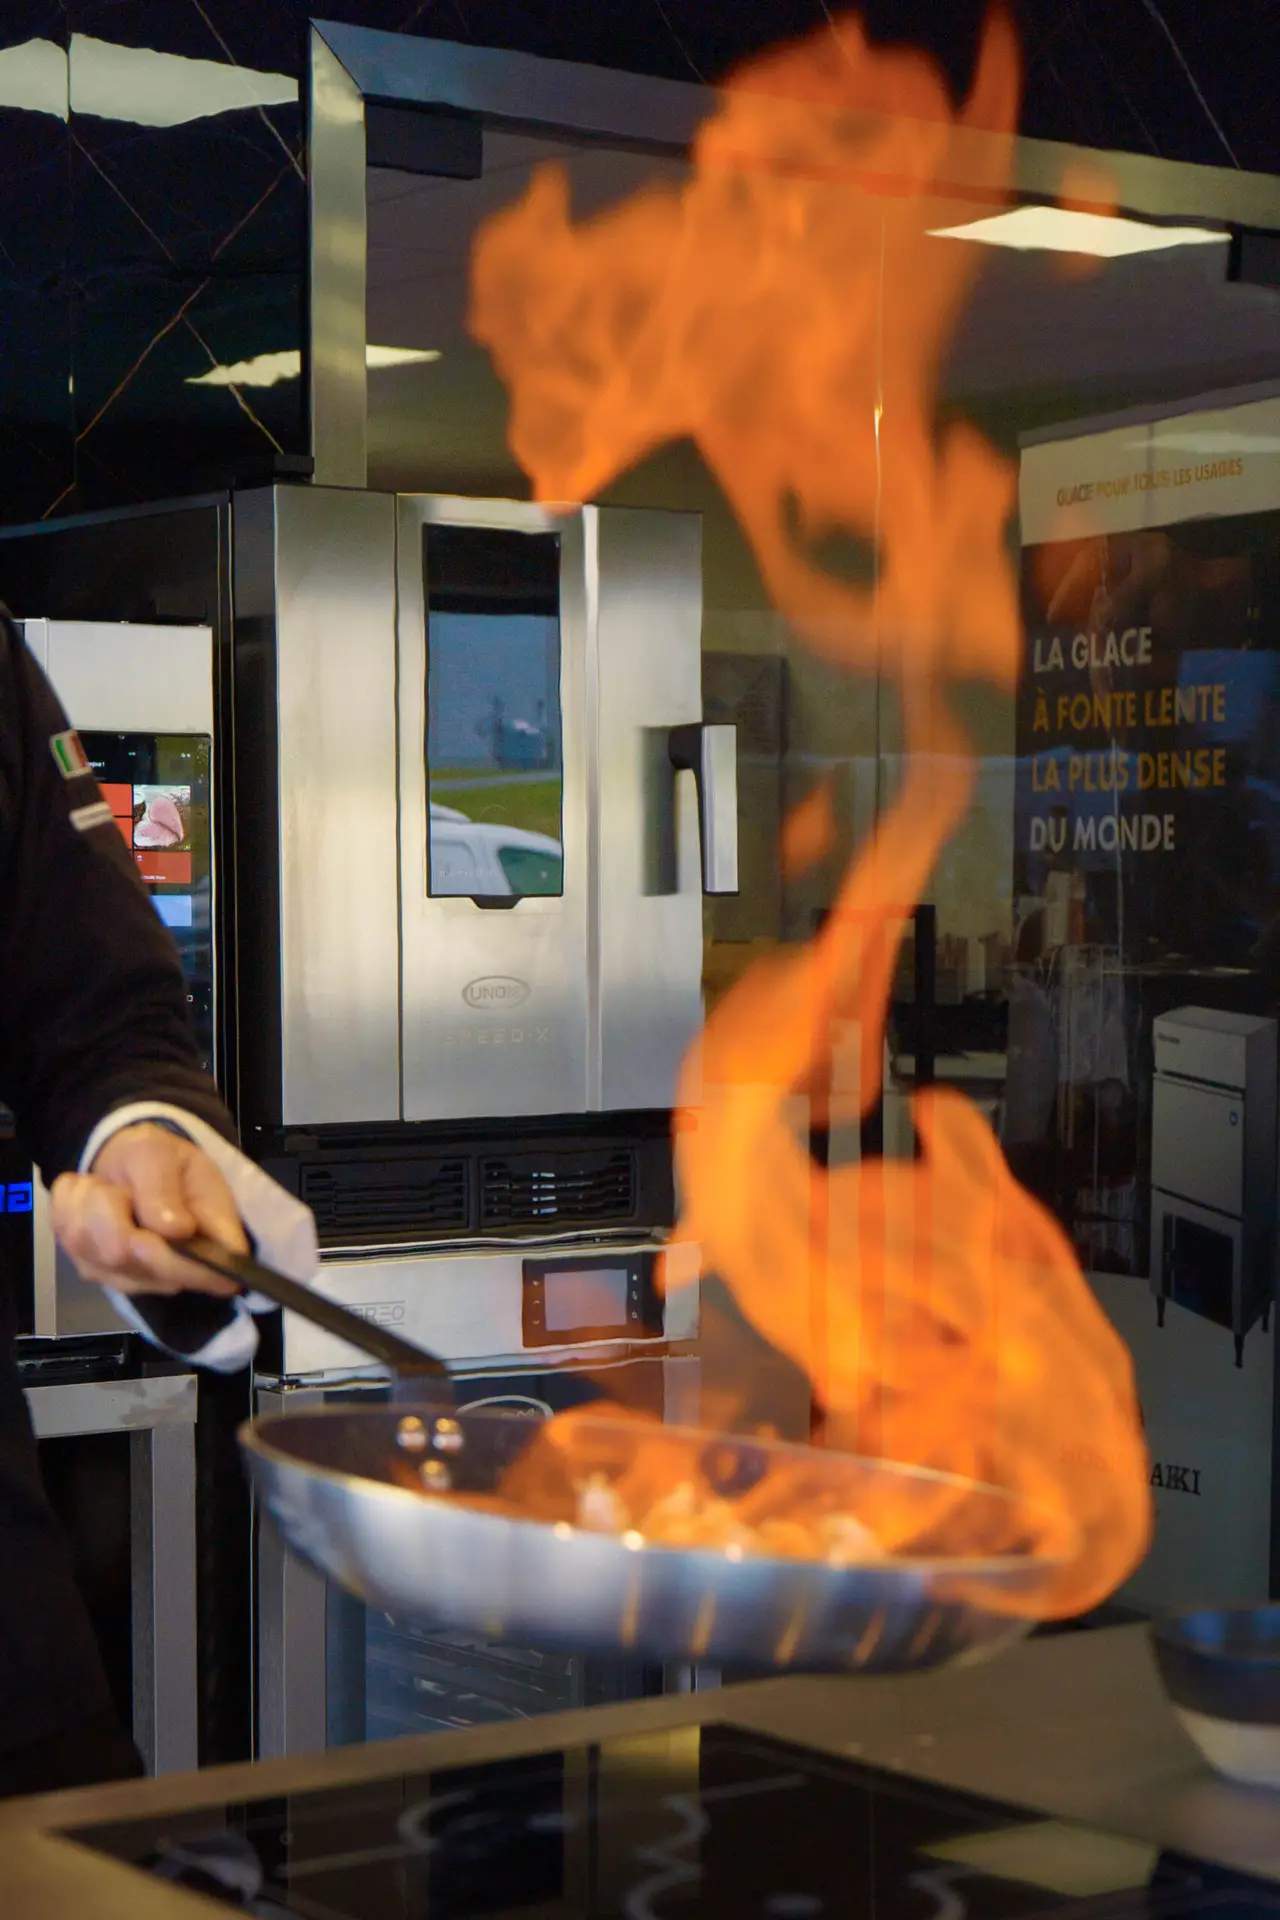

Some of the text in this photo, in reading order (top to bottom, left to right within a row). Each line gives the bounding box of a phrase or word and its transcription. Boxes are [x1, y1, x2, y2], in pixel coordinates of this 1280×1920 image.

[1173, 468, 1192, 487] LES
[1195, 457, 1244, 482] USAGES
[1033, 626, 1153, 674] LA GLACE
[1032, 683, 1226, 733] À FONTE LENTE
[1031, 748, 1226, 793] LA PLUS DENSE
[1029, 813, 1176, 853] DU MONDE
[470, 985, 522, 1001] UNOX
